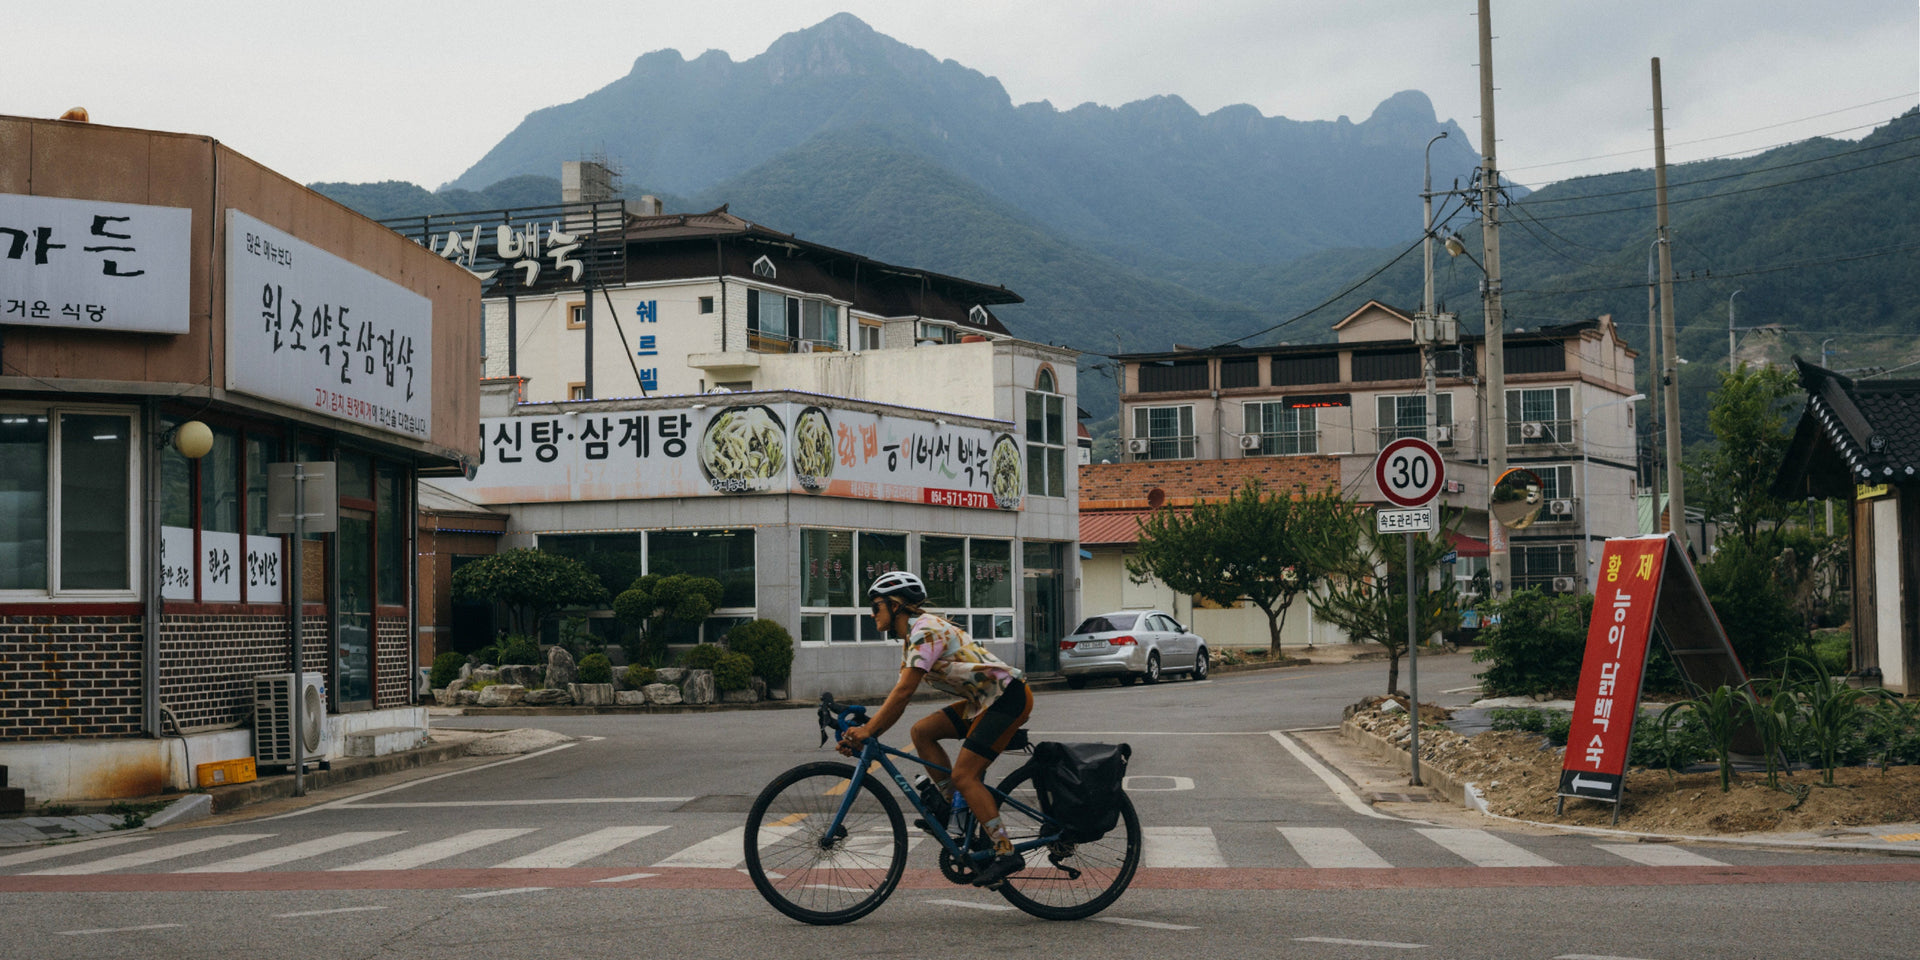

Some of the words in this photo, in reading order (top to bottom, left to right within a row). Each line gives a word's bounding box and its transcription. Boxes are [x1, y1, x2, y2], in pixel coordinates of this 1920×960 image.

[246, 232, 261, 256] 많은
[263, 239, 293, 270] 메뉴보다
[497, 220, 584, 287] 백숙
[0, 300, 51, 319] 거운
[61, 303, 107, 323] 식당
[262, 283, 415, 402] 원조약돌삼겹살
[636, 300, 658, 391] 쉐르빌
[958, 436, 990, 488] 백숙
[1392, 456, 1428, 489] 30
[931, 491, 988, 508] 054-571-3770
[1380, 513, 1430, 528] 속도관리구역
[208, 548, 231, 585] 한우
[248, 550, 278, 587] 갈비살
